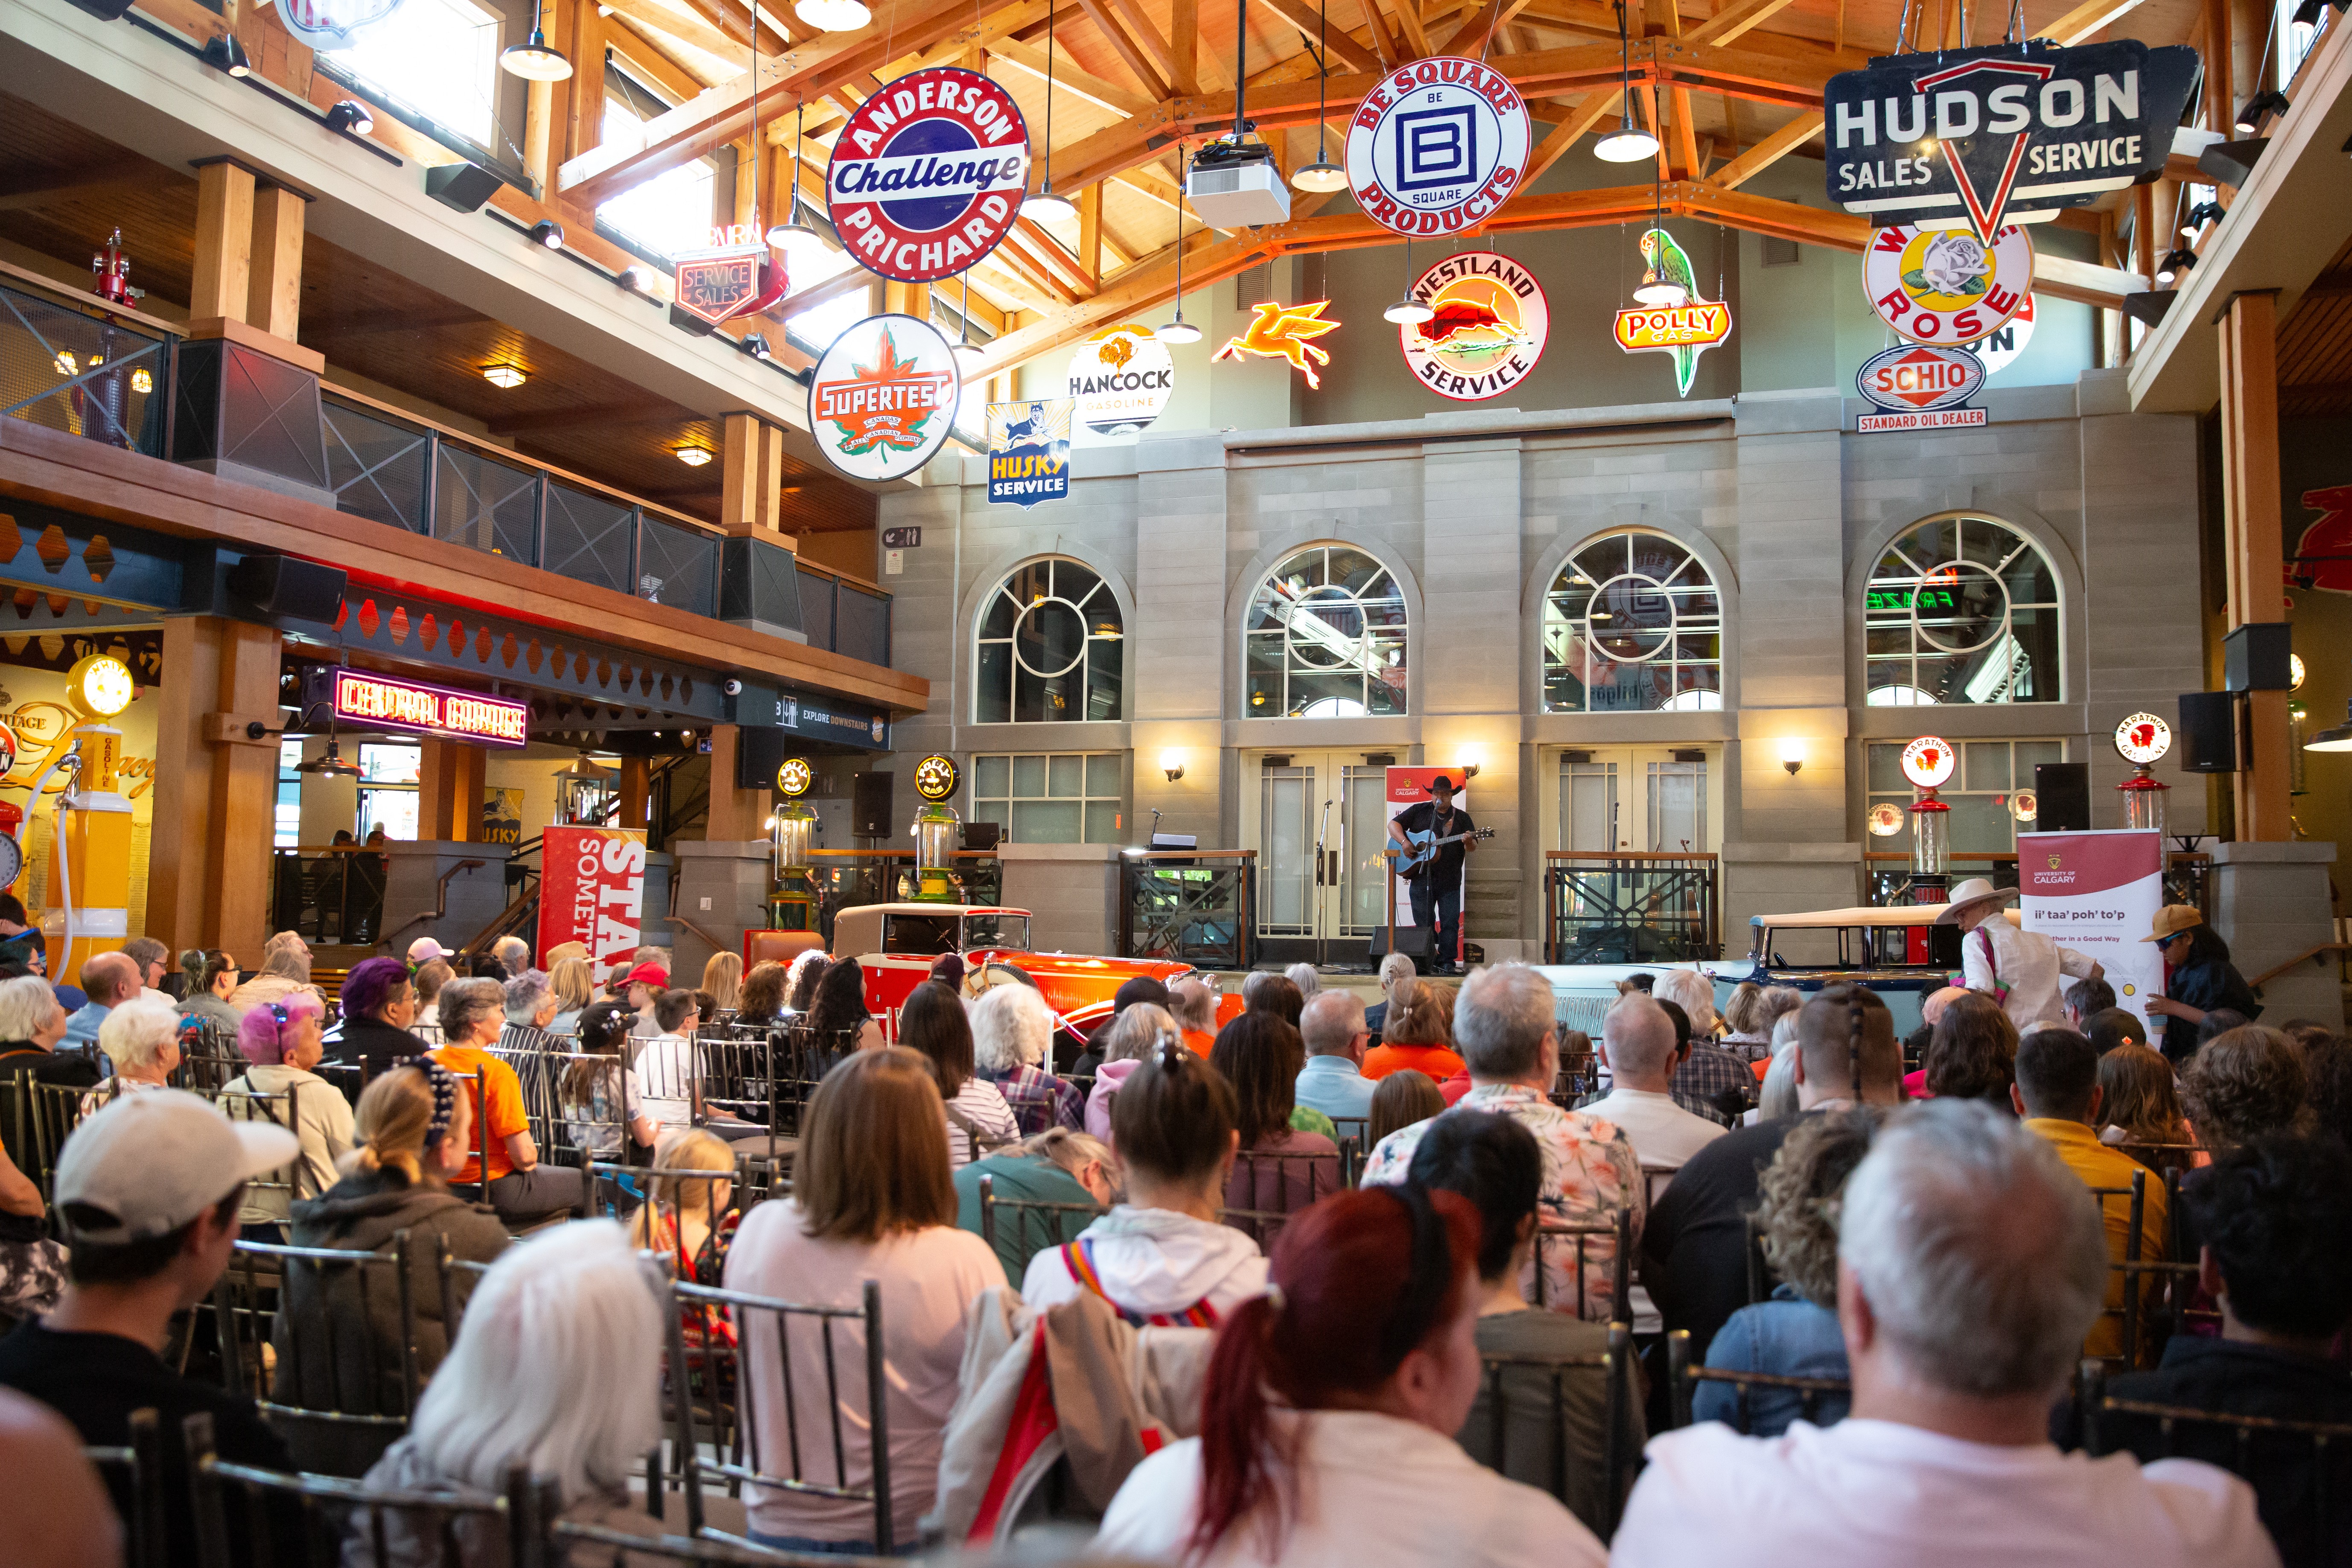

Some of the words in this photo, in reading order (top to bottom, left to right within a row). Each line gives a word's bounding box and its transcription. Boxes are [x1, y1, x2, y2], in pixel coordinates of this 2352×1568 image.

[1355, 88, 1393, 131] BE
[1394, 61, 1518, 116] SQUARE
[1427, 92, 1442, 103] BE
[852, 80, 1013, 156] ANDERSON
[1835, 70, 2139, 149] HUDSON
[835, 156, 1021, 194] Challenge
[1838, 156, 1932, 191] SALES
[2029, 135, 2142, 175] SERVICE
[1358, 165, 1517, 234] PRODUCTS
[1412, 189, 1462, 204] SQUARE
[844, 195, 1009, 271] PRICHARD
[684, 265, 749, 288] SERVICE
[1414, 256, 1535, 304] WESTLAND
[694, 286, 739, 307] SALES
[1878, 283, 2019, 339] ROSE
[1625, 307, 1720, 340] POLLY
[1651, 330, 1693, 342] GAS
[1069, 370, 1171, 395] HANCOCK
[1420, 354, 1529, 394] SERVICE
[821, 375, 948, 417] SUPERTEST
[1086, 397, 1154, 411] GASOLINE
[1861, 415, 1917, 431] STANDARD
[1921, 413, 1939, 426] OIL
[1942, 411, 1984, 425] DEALER
[865, 430, 899, 439] CANADIAN
[992, 454, 1067, 479] HUSKY
[993, 478, 1064, 496] SERVICE
[340, 678, 443, 727] CENTRAL
[445, 697, 526, 739] GARAGE
[803, 710, 830, 724] EXPLORE
[831, 715, 868, 731] DOWNSTAIRS
[2119, 715, 2167, 734] MARATHON
[1905, 739, 1951, 758] MARATHON
[2121, 744, 2166, 760] GASOLINE
[102, 738, 112, 787] GASOLINE
[781, 762, 808, 778] POLLY
[919, 760, 950, 778] POLLY
[482, 829, 520, 844] USKY
